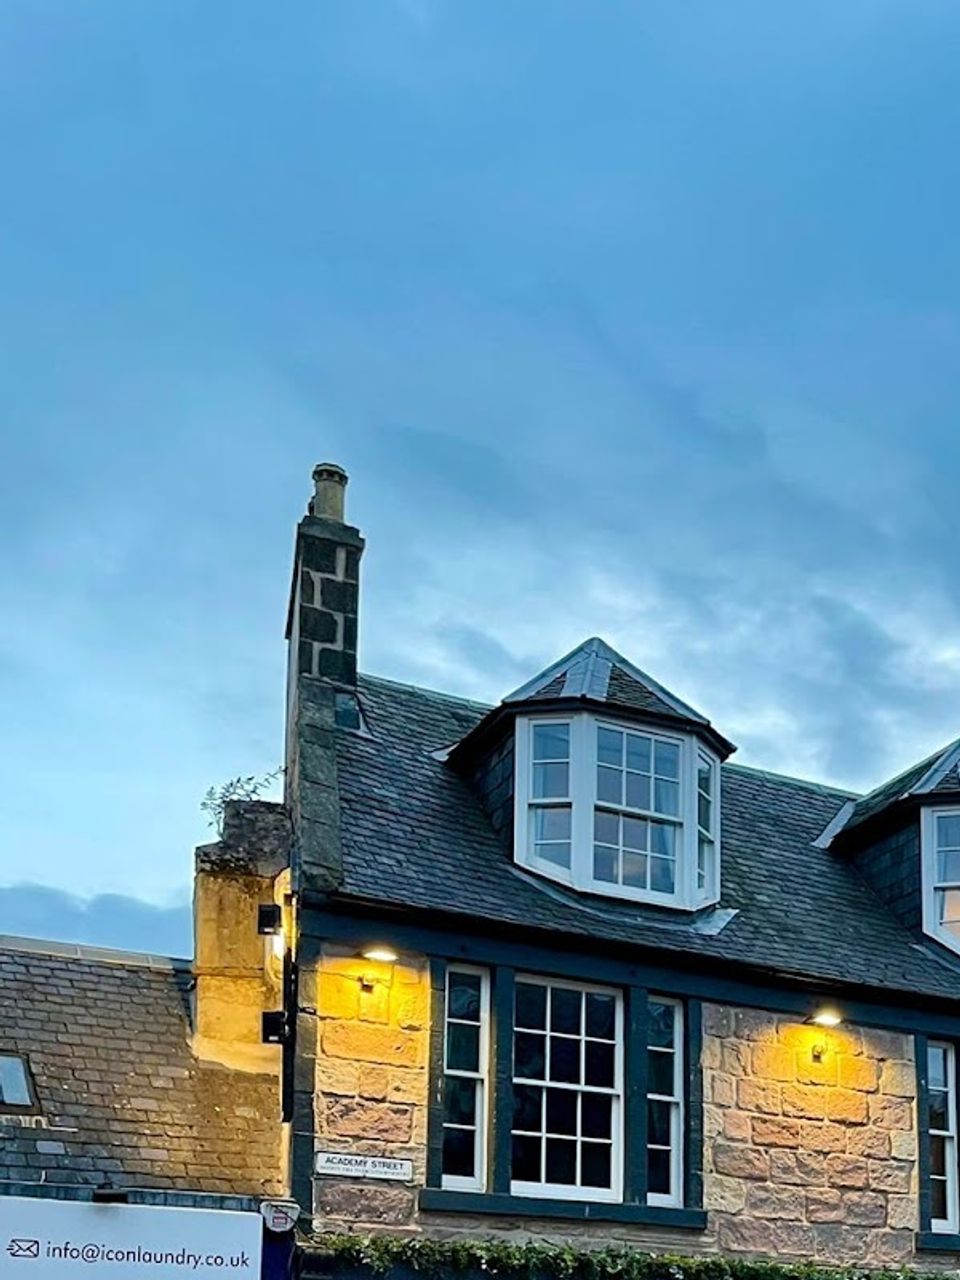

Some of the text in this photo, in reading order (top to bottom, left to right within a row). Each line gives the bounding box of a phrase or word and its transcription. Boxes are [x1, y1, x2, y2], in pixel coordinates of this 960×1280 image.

[325, 1156, 367, 1169] ACADEMY
[371, 1160, 404, 1171] STREET
[46, 1241, 250, 1269] info@iconlaundry.co.uk
